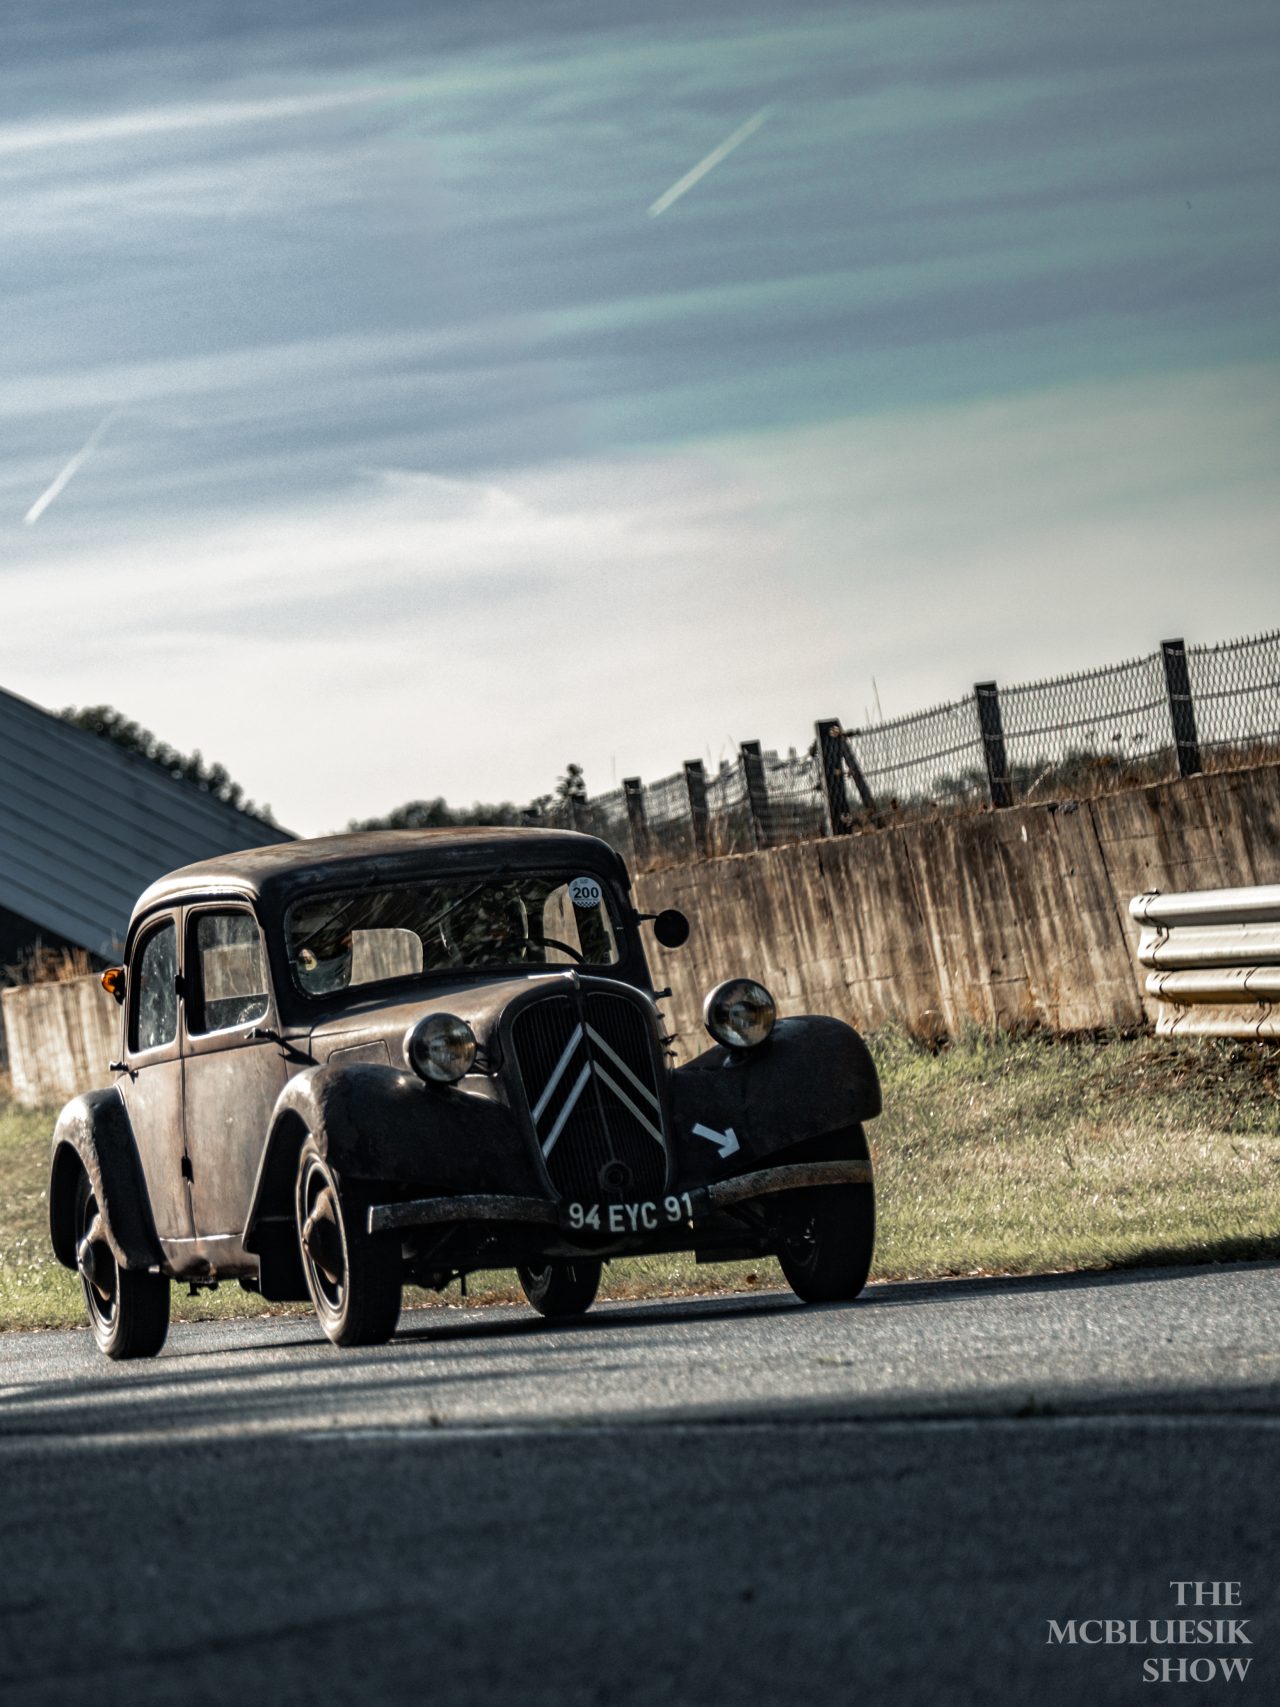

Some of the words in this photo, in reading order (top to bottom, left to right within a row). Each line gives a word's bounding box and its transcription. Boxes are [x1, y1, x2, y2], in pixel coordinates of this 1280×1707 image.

[573, 887, 599, 899] 200
[569, 1203, 601, 1230] 94
[609, 1202, 658, 1232] EYC
[664, 1192, 693, 1222] 91
